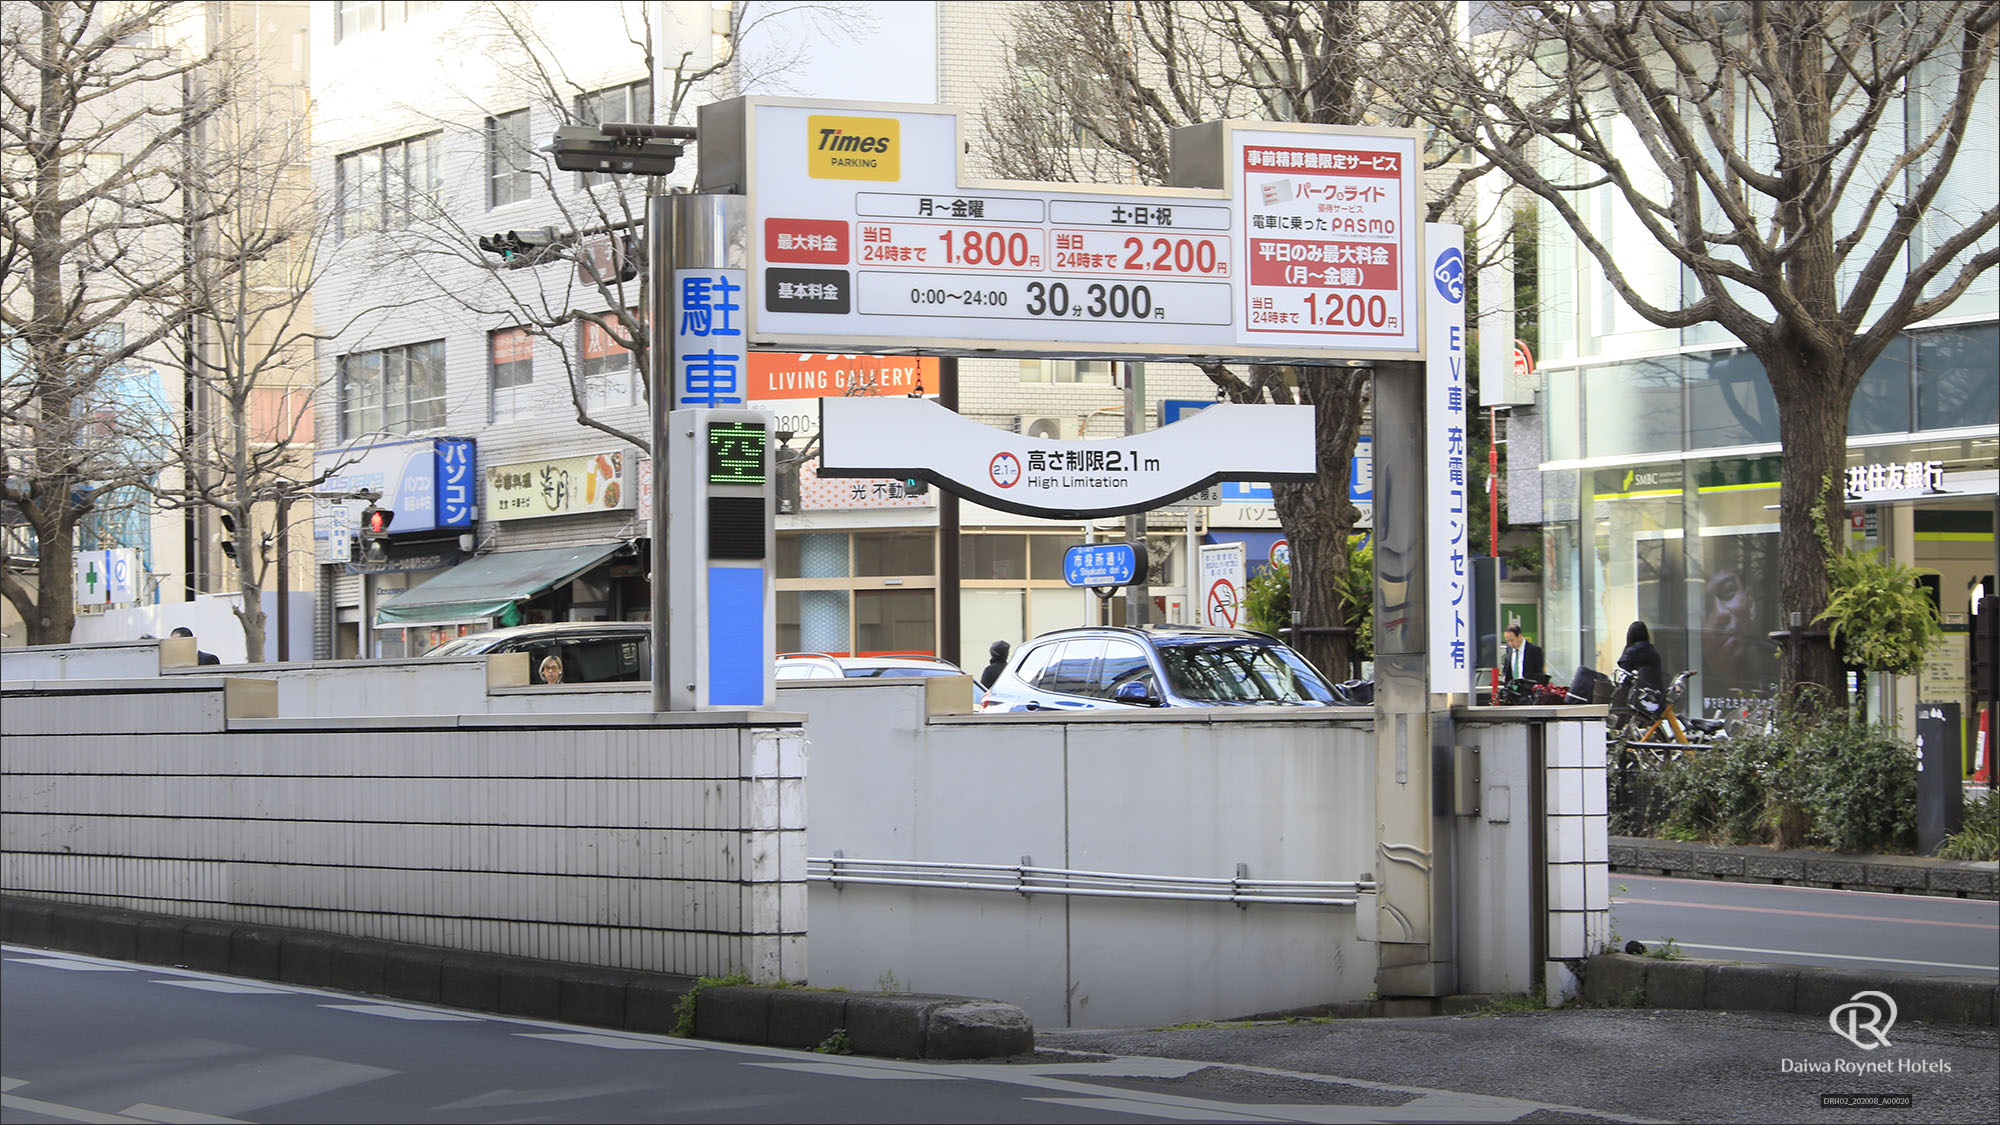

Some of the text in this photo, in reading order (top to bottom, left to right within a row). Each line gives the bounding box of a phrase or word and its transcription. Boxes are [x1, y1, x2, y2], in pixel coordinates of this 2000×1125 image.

[818, 128, 890, 154] Times
[831, 157, 877, 169] PARKING
[1247, 150, 1398, 172] 事前精算機限定サービス
[1252, 214, 1395, 235] 電車に乗った PASMO
[777, 232, 838, 252] 最大料金
[863, 227, 892, 243] 当日
[1056, 234, 1083, 250] 当日
[864, 245, 927, 262] 24時まで
[1057, 251, 1118, 269] 24時まで
[1259, 242, 1389, 265] 平日のみ最大料金
[778, 281, 839, 302] 基本料金
[1252, 296, 1273, 310] 当日
[1252, 310, 1300, 325] 24時まで
[680, 275, 741, 408] 駐車
[769, 368, 914, 390] LIVING GALLERY
[710, 422, 766, 483] 空
[444, 444, 468, 525] パソコン
[1028, 476, 1128, 489] High Limitation
[1634, 472, 1658, 486] SMBC
[851, 484, 867, 500] 光
